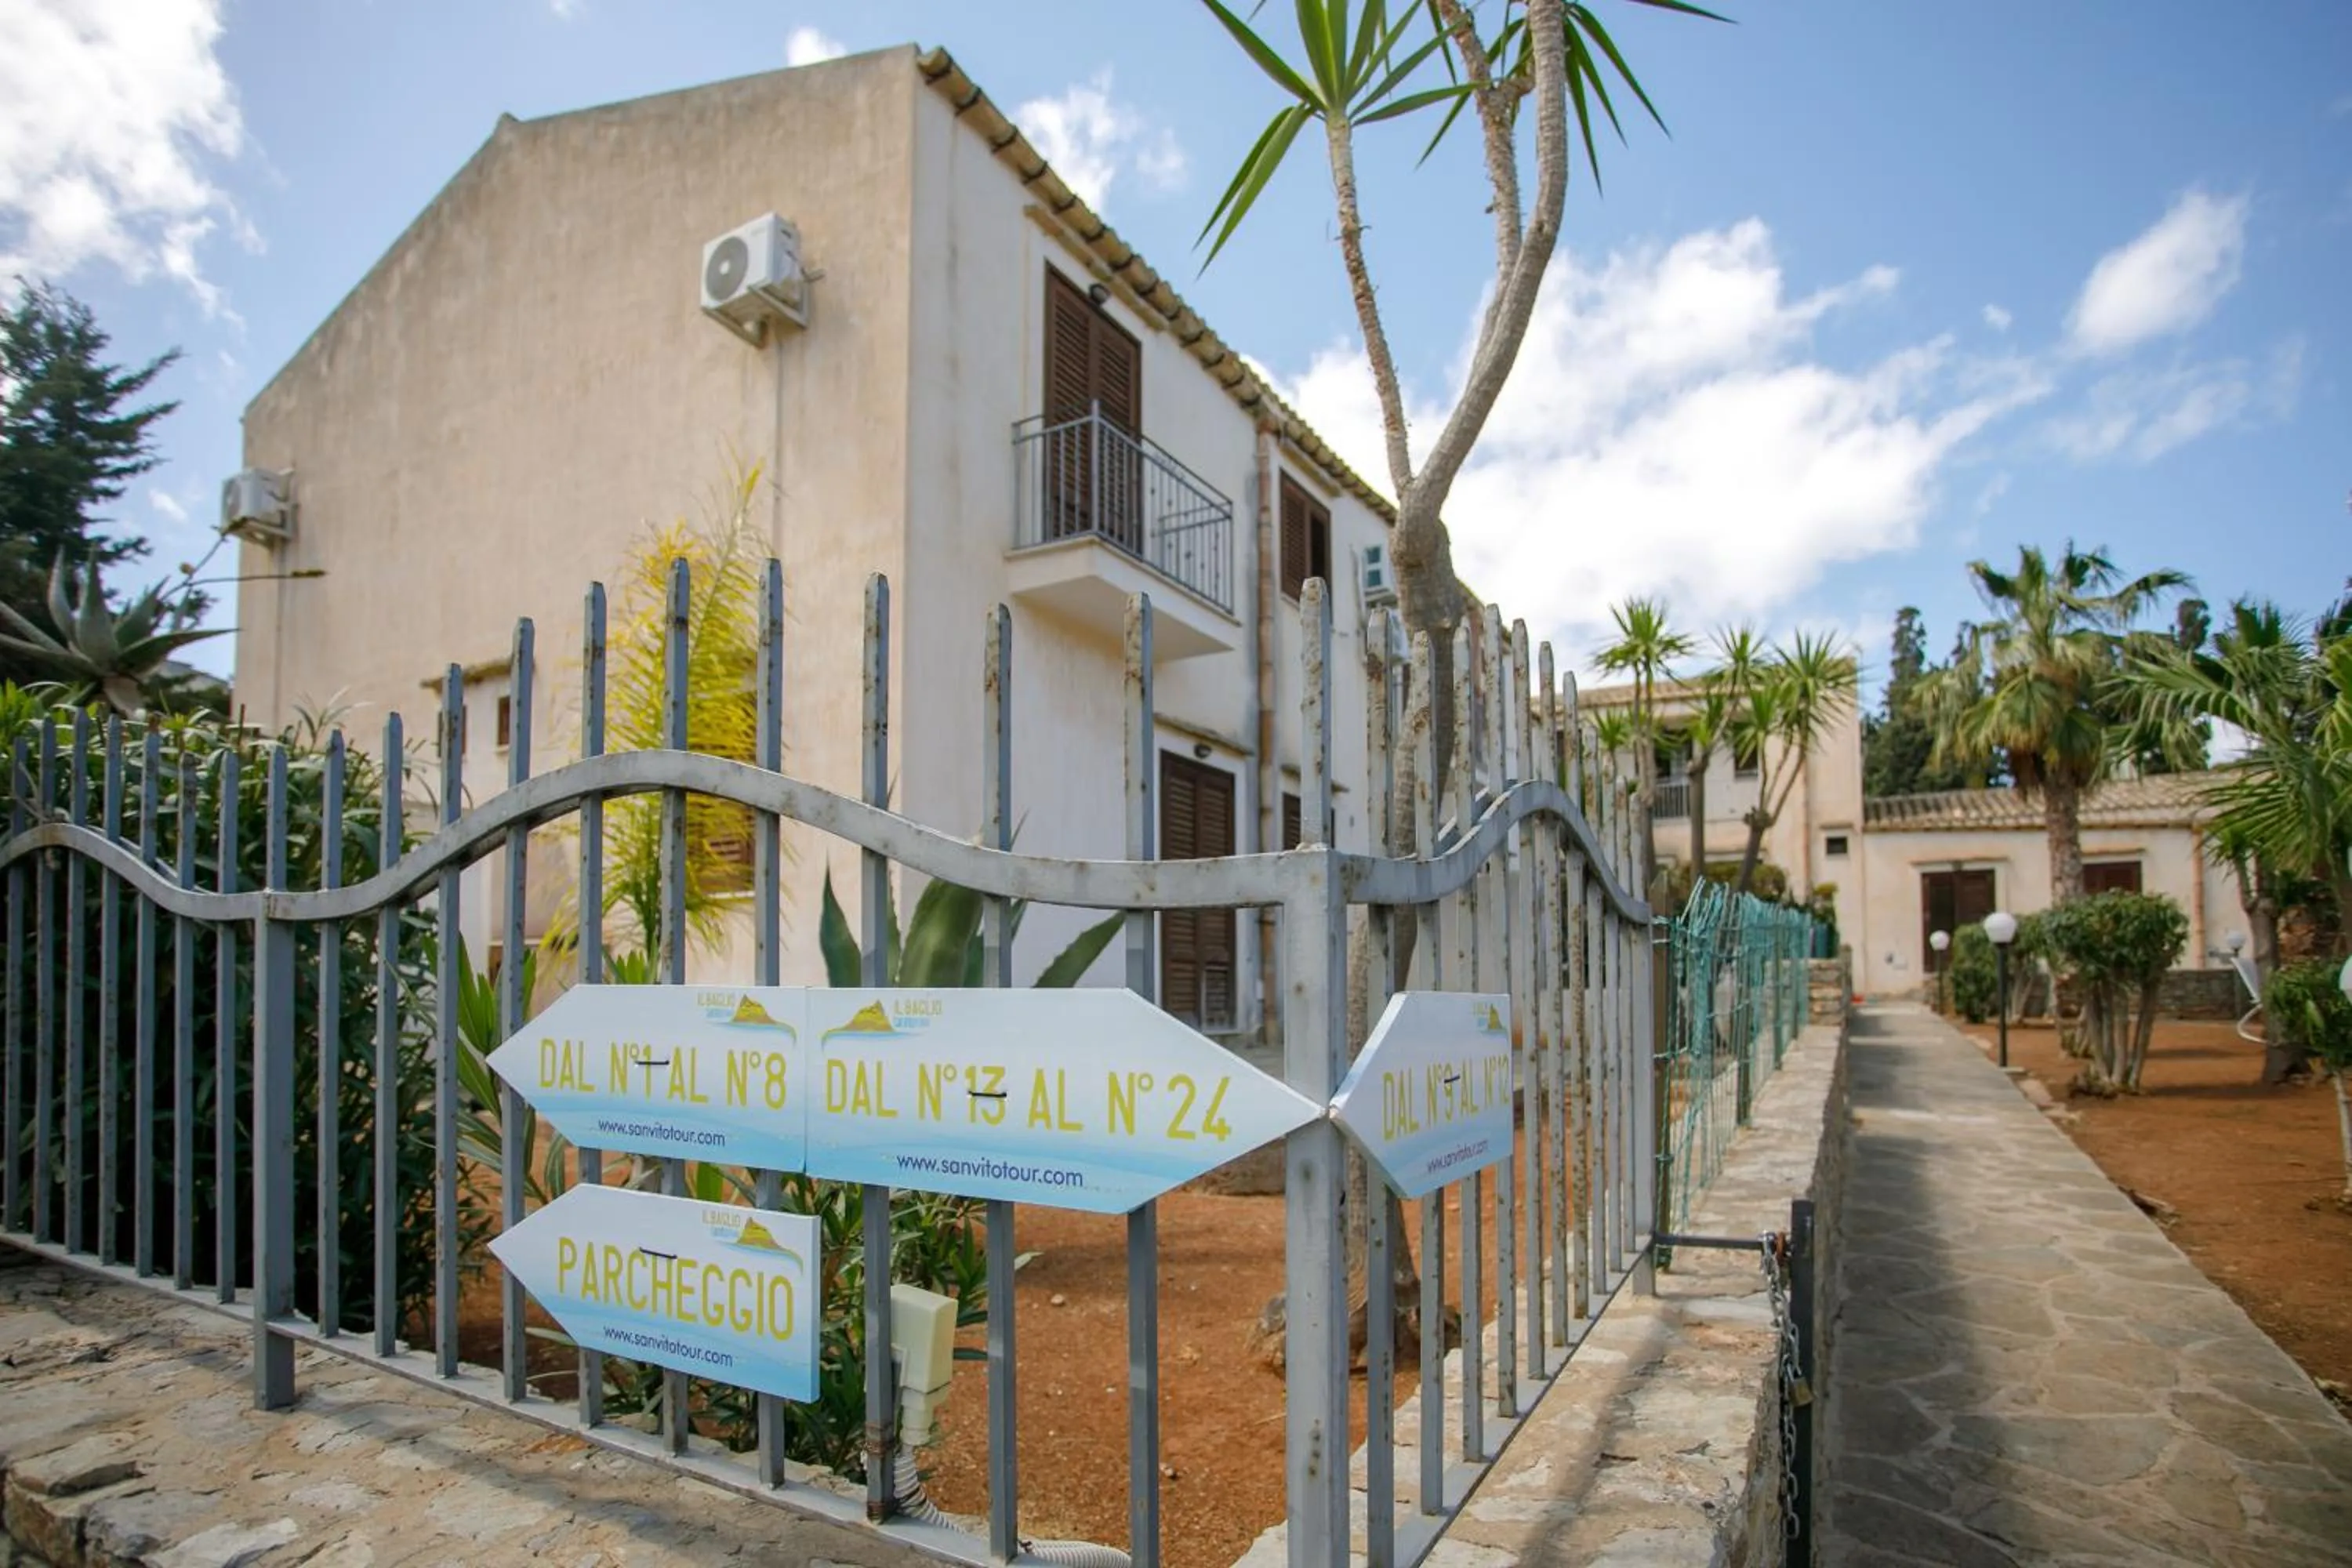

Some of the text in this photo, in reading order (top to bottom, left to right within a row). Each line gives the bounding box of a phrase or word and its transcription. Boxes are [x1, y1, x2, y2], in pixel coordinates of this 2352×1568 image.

[539, 1038, 595, 1092] DAL
[667, 1046, 709, 1103] AL
[826, 1058, 898, 1119] DAL
[1027, 1068, 1083, 1132] AL
[1382, 1065, 1420, 1142] DAL
[1460, 1057, 1479, 1116] AL
[598, 1120, 726, 1146] www.sanvitotour.com
[896, 1154, 1083, 1187] www.sanvitotour.com
[557, 1236, 794, 1341] PARCHEGGIO
[603, 1325, 734, 1367] www.sanvitotour.com
